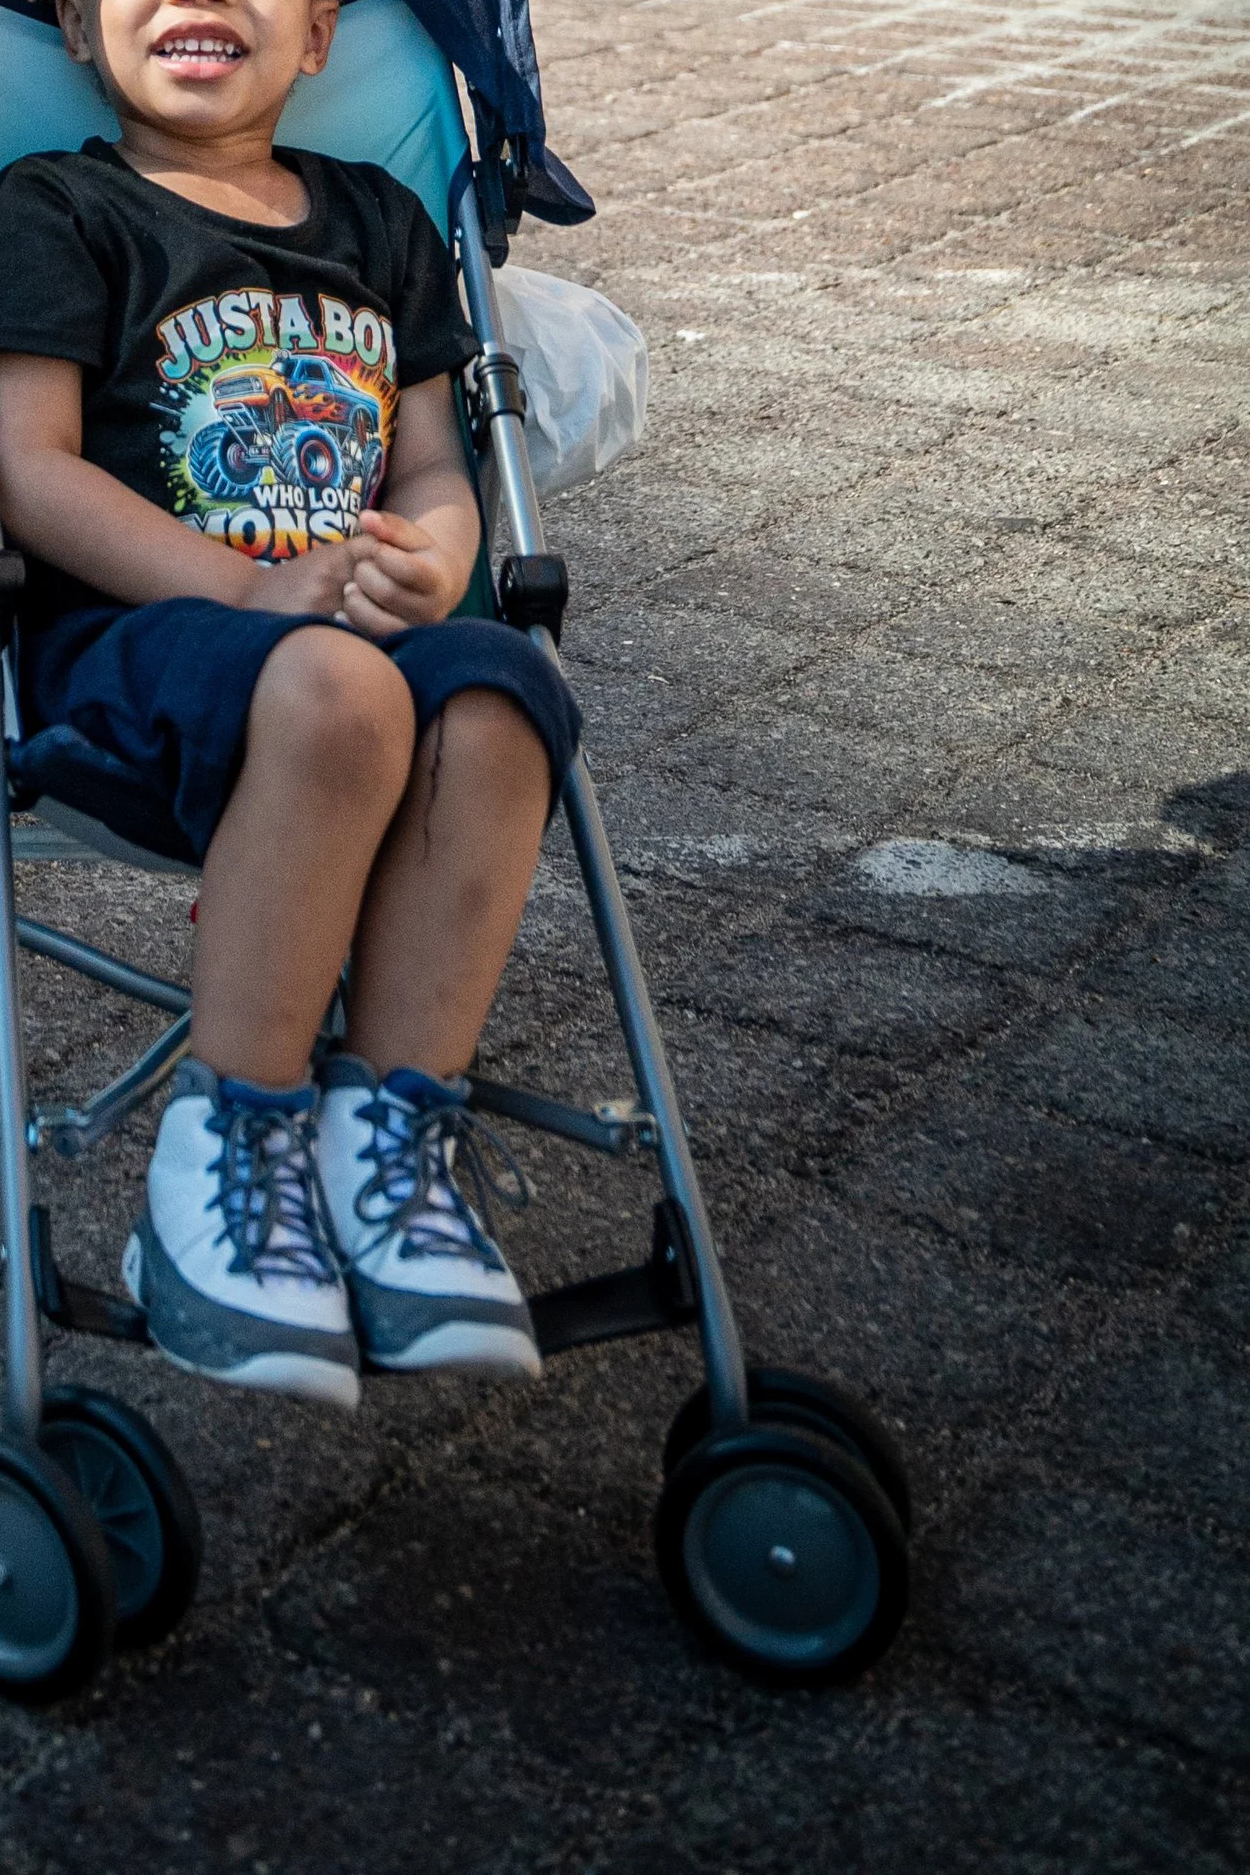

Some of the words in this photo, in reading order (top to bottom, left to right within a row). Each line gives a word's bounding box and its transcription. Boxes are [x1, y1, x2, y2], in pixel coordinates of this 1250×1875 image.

[159, 290, 276, 381] JUST
[278, 296, 319, 350] A
[252, 484, 305, 508] WHO
[308, 486, 361, 515] LOVE
